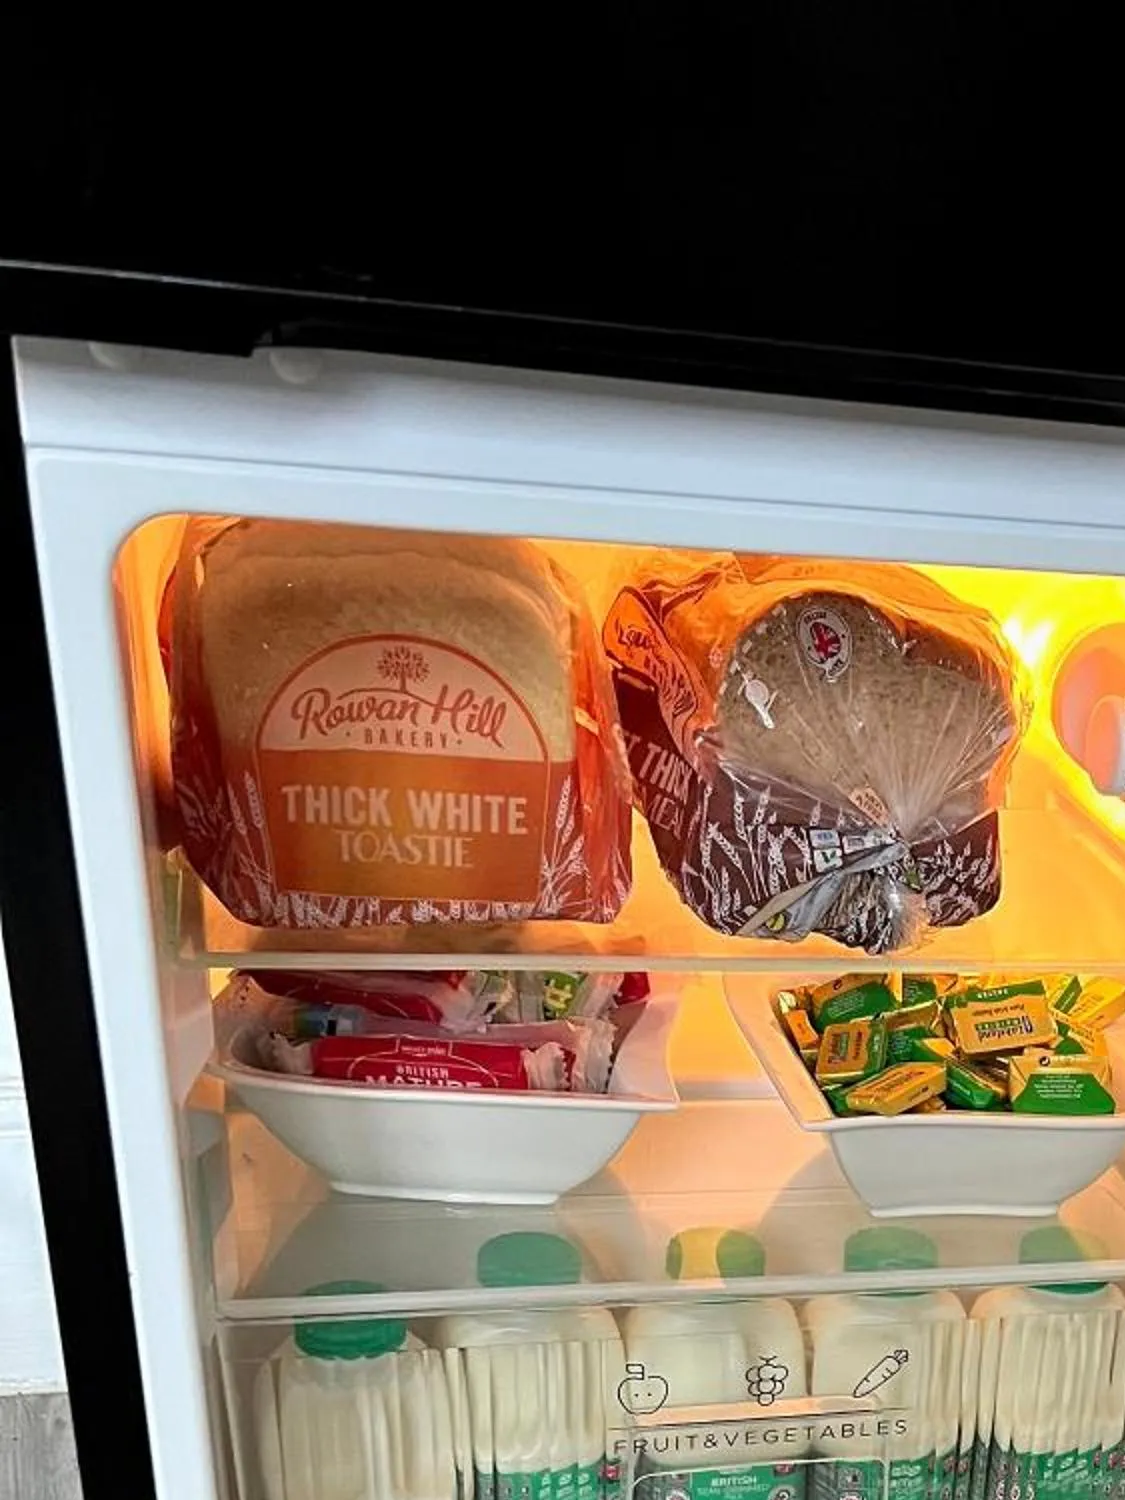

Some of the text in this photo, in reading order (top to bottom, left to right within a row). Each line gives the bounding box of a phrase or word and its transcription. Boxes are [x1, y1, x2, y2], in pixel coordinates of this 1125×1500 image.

[291, 684, 508, 749] Rowan Hill
[364, 728, 449, 749] BAKERY
[281, 784, 529, 836] THICK WHITE
[336, 830, 474, 868] TOASTIE
